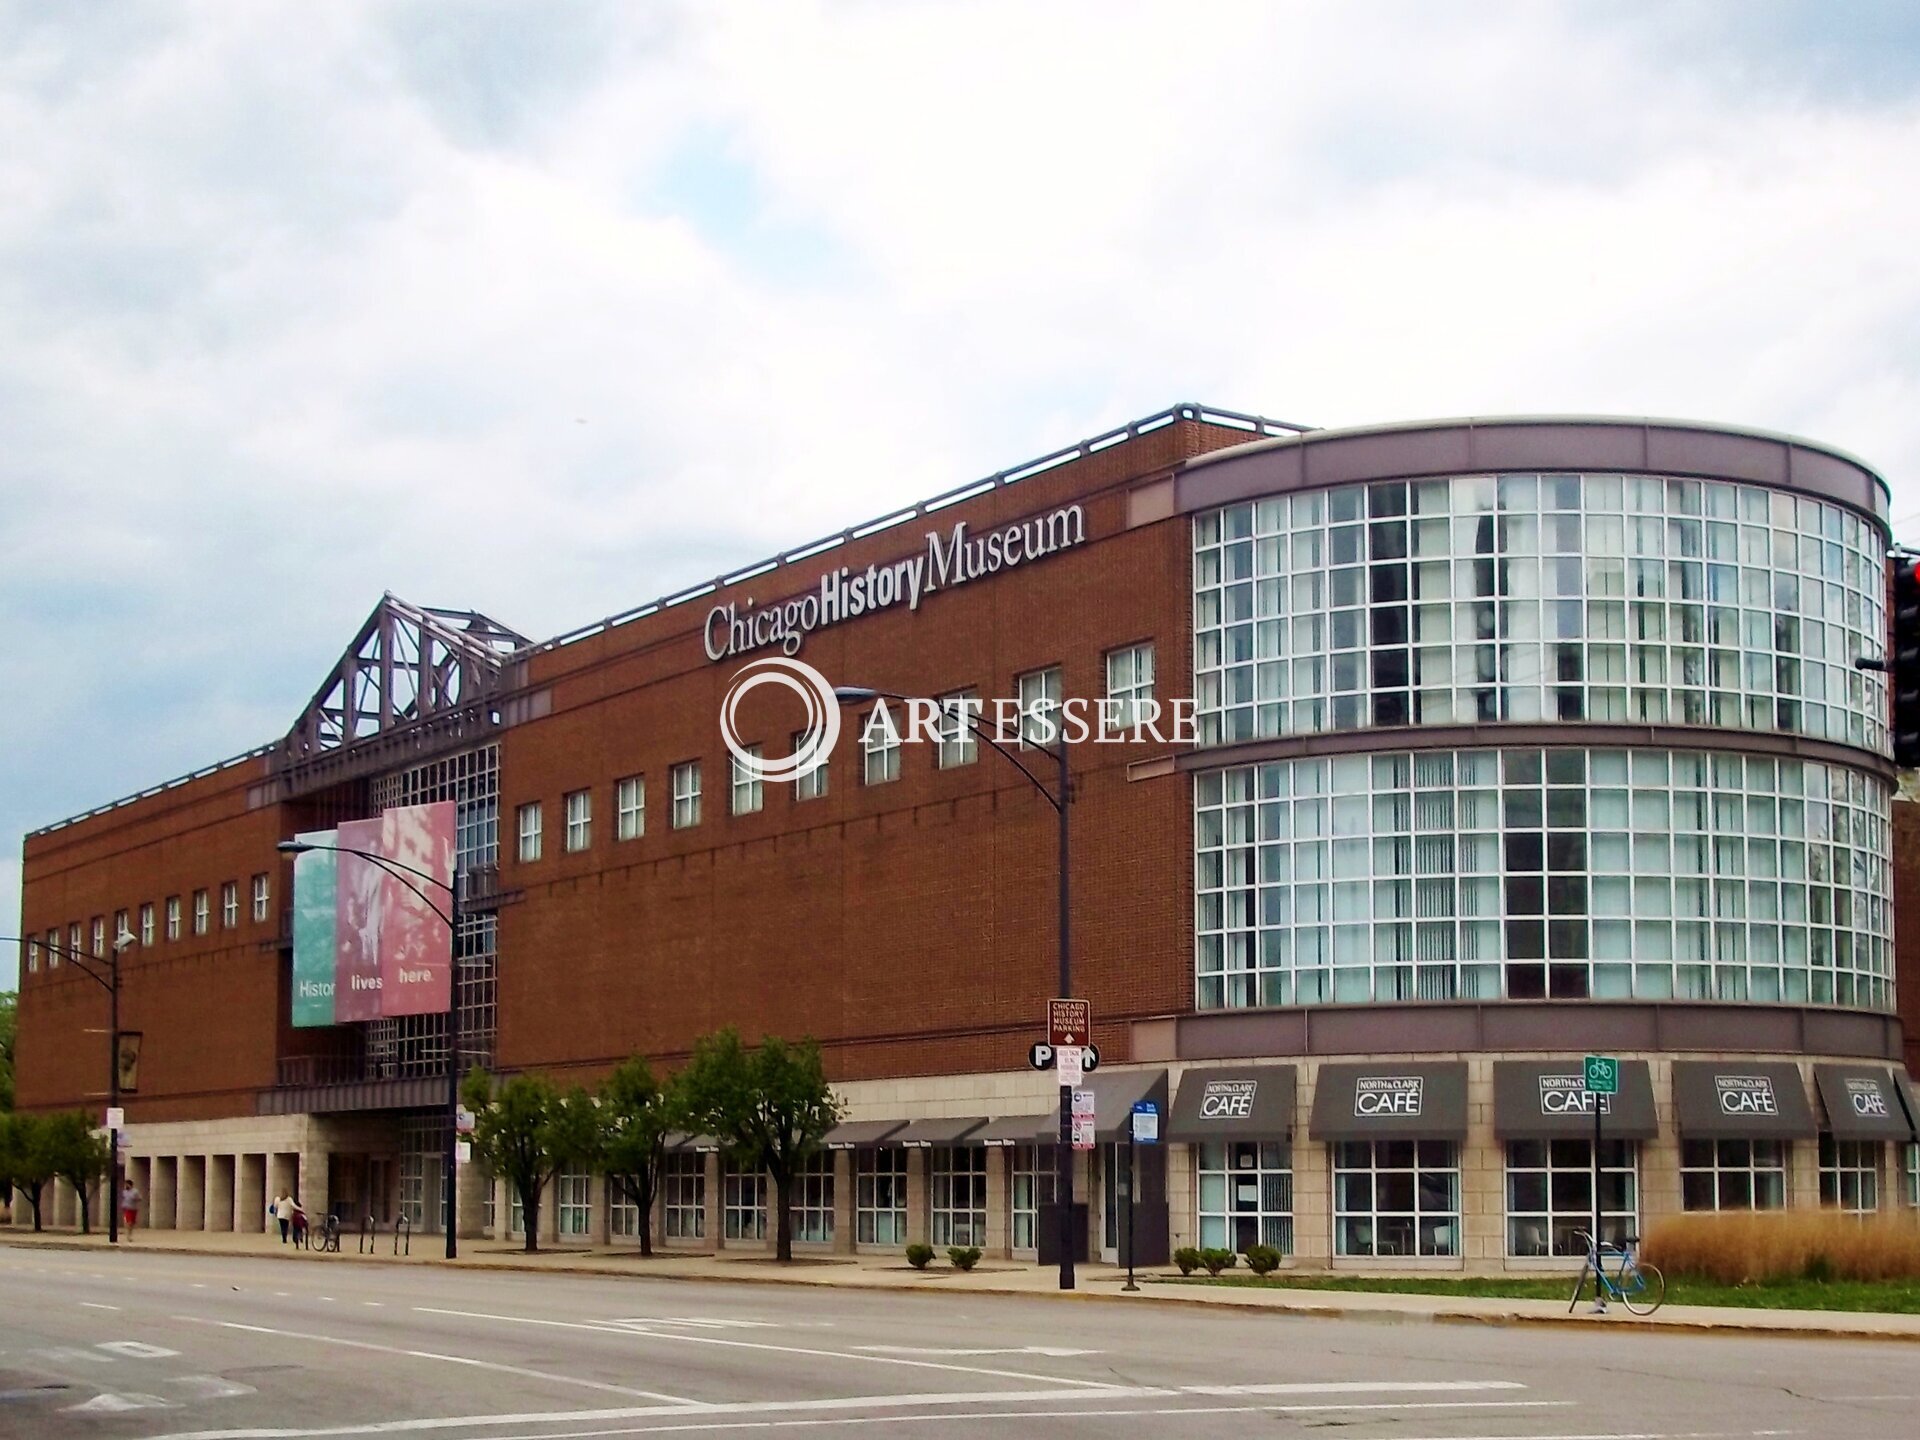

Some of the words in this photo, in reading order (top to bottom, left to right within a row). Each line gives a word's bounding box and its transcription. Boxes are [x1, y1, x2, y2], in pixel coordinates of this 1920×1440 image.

[299, 980, 336, 998] Histor
[351, 974, 384, 991] lives
[1052, 1002, 1085, 1010] CHICAGO
[1053, 1010, 1084, 1018] HISTORY
[1053, 1017, 1085, 1025] MUSEUM
[1053, 1024, 1086, 1032] PARKING
[1034, 1045, 1052, 1067] P
[1203, 1091, 1252, 1116] CAFÉ
[1358, 1088, 1419, 1113] CAFÉ
[1722, 1088, 1776, 1112] CAFÉ
